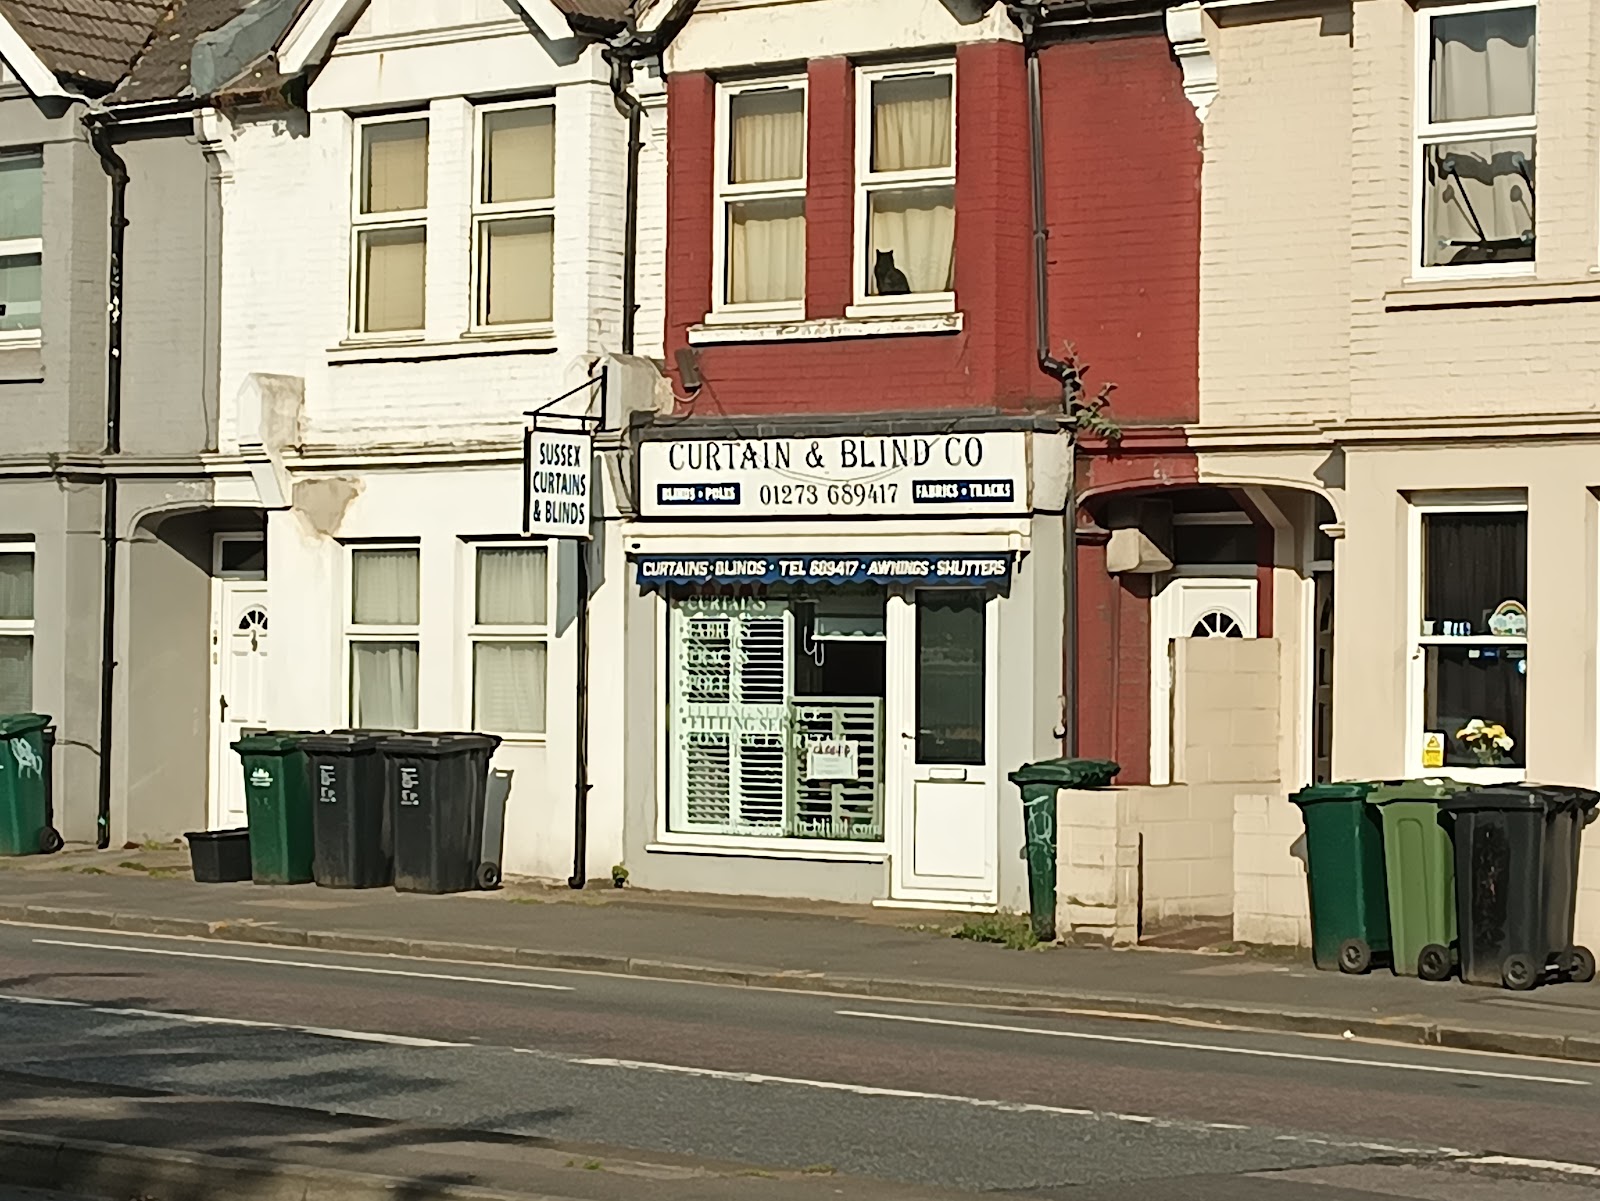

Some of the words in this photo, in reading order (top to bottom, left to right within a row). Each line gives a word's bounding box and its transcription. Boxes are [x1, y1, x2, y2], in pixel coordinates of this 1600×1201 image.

[539, 442, 581, 467] SUSSEX
[668, 441, 791, 471] CURTAIN
[805, 440, 826, 468] &
[841, 438, 930, 468] BLIND
[945, 436, 983, 467] CO
[533, 470, 586, 496] CURTAINS
[759, 484, 819, 506] 01273
[826, 482, 899, 507] 689417
[915, 483, 959, 499] FABRICS
[533, 499, 541, 522] &
[545, 500, 585, 525] BLINDS
[642, 560, 709, 577] CURTAINS
[714, 559, 767, 576] BLINDS
[778, 560, 806, 577] TEL
[809, 559, 860, 577] 689417
[866, 559, 930, 576] AWNINGS
[936, 559, 1006, 576] SHUTTERS
